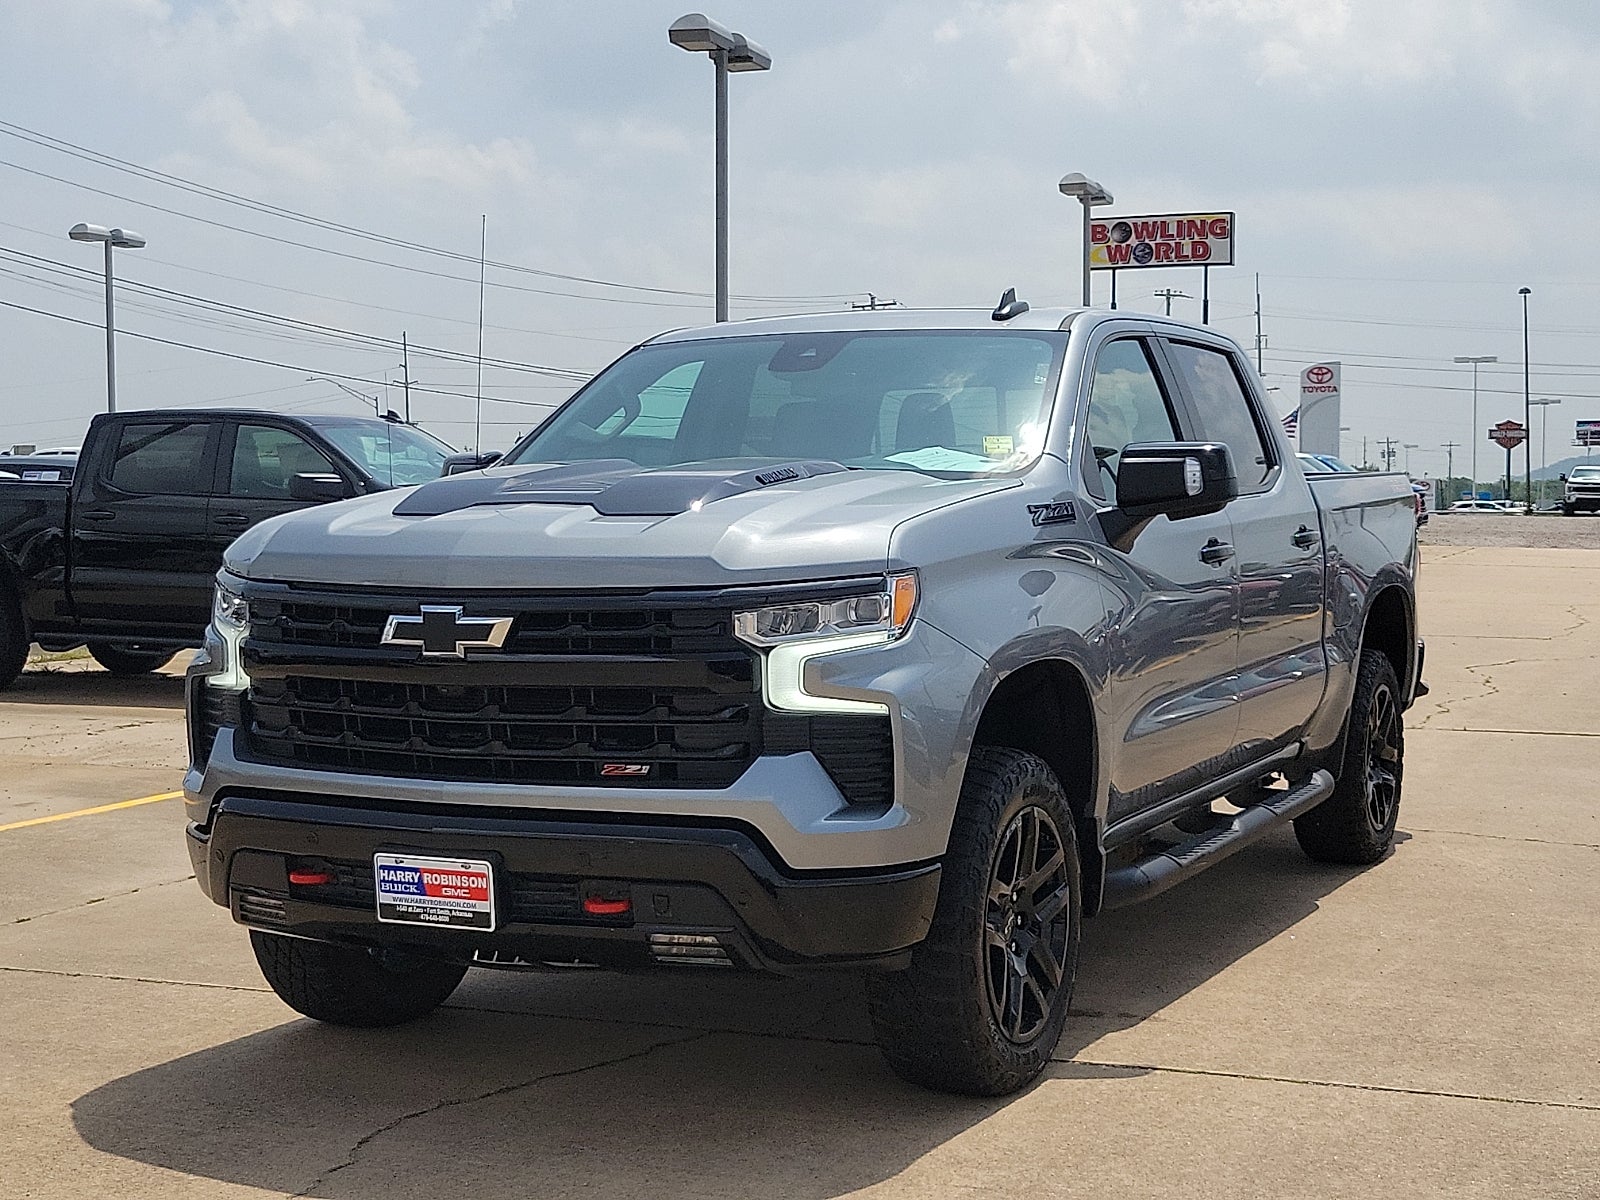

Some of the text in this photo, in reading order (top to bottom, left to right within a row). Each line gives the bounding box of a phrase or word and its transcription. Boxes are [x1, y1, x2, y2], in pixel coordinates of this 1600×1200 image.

[1091, 218, 1228, 243] BOWLING
[1106, 240, 1212, 265] WORLD
[601, 764, 650, 776] Z71
[380, 869, 487, 889] HARRY ROBINSON
[381, 882, 470, 897] BUICK GMC
[392, 896, 477, 910] WWW.HARRYROBINSON.COM
